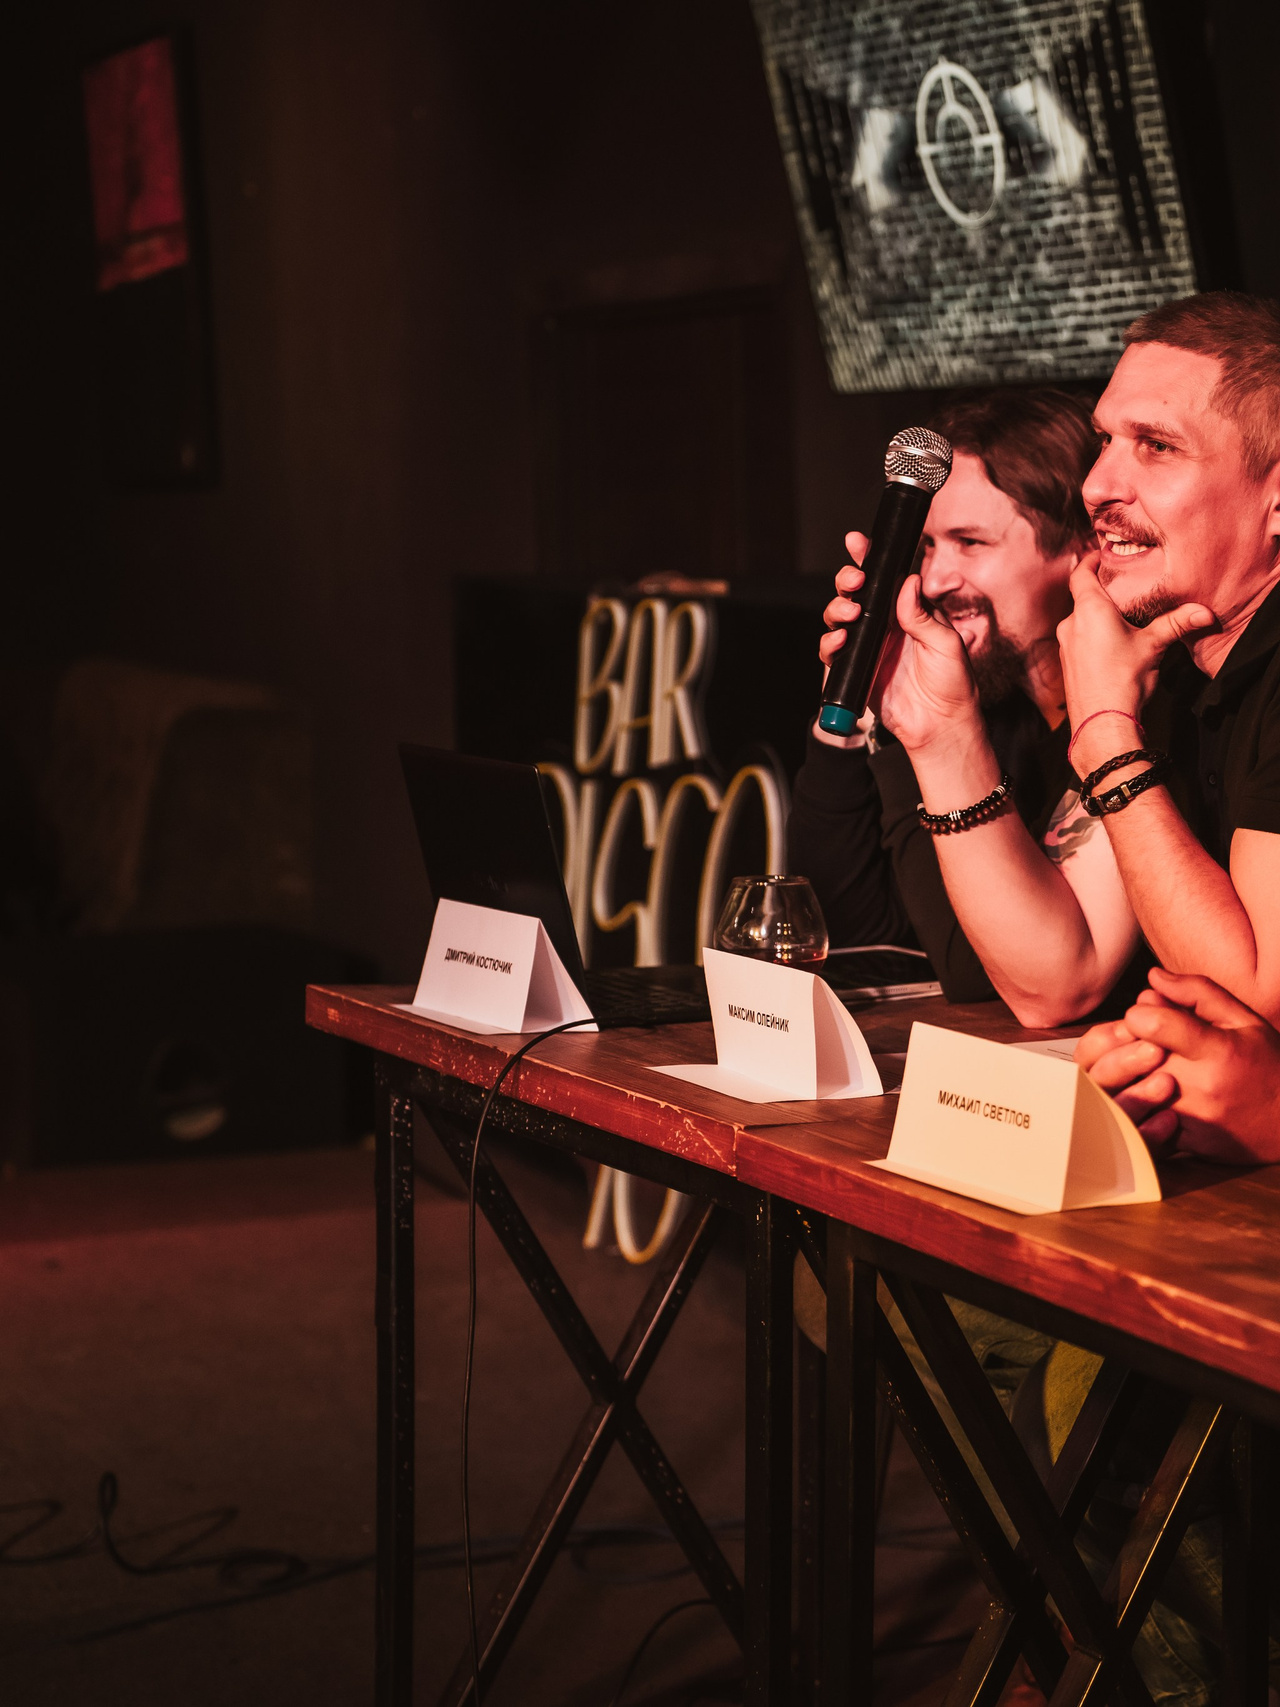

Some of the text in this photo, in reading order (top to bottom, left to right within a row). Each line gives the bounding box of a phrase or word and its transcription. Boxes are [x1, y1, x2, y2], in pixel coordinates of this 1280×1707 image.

[573, 598, 704, 773] BAR
[444, 948, 513, 974] ДМИТРИЙ КОСТЮЧИК
[728, 1003, 789, 1033] МАКСИМ ОЛЕЙНИК
[938, 1090, 1031, 1129] МИХАИЛ СВЕТЛОВ
